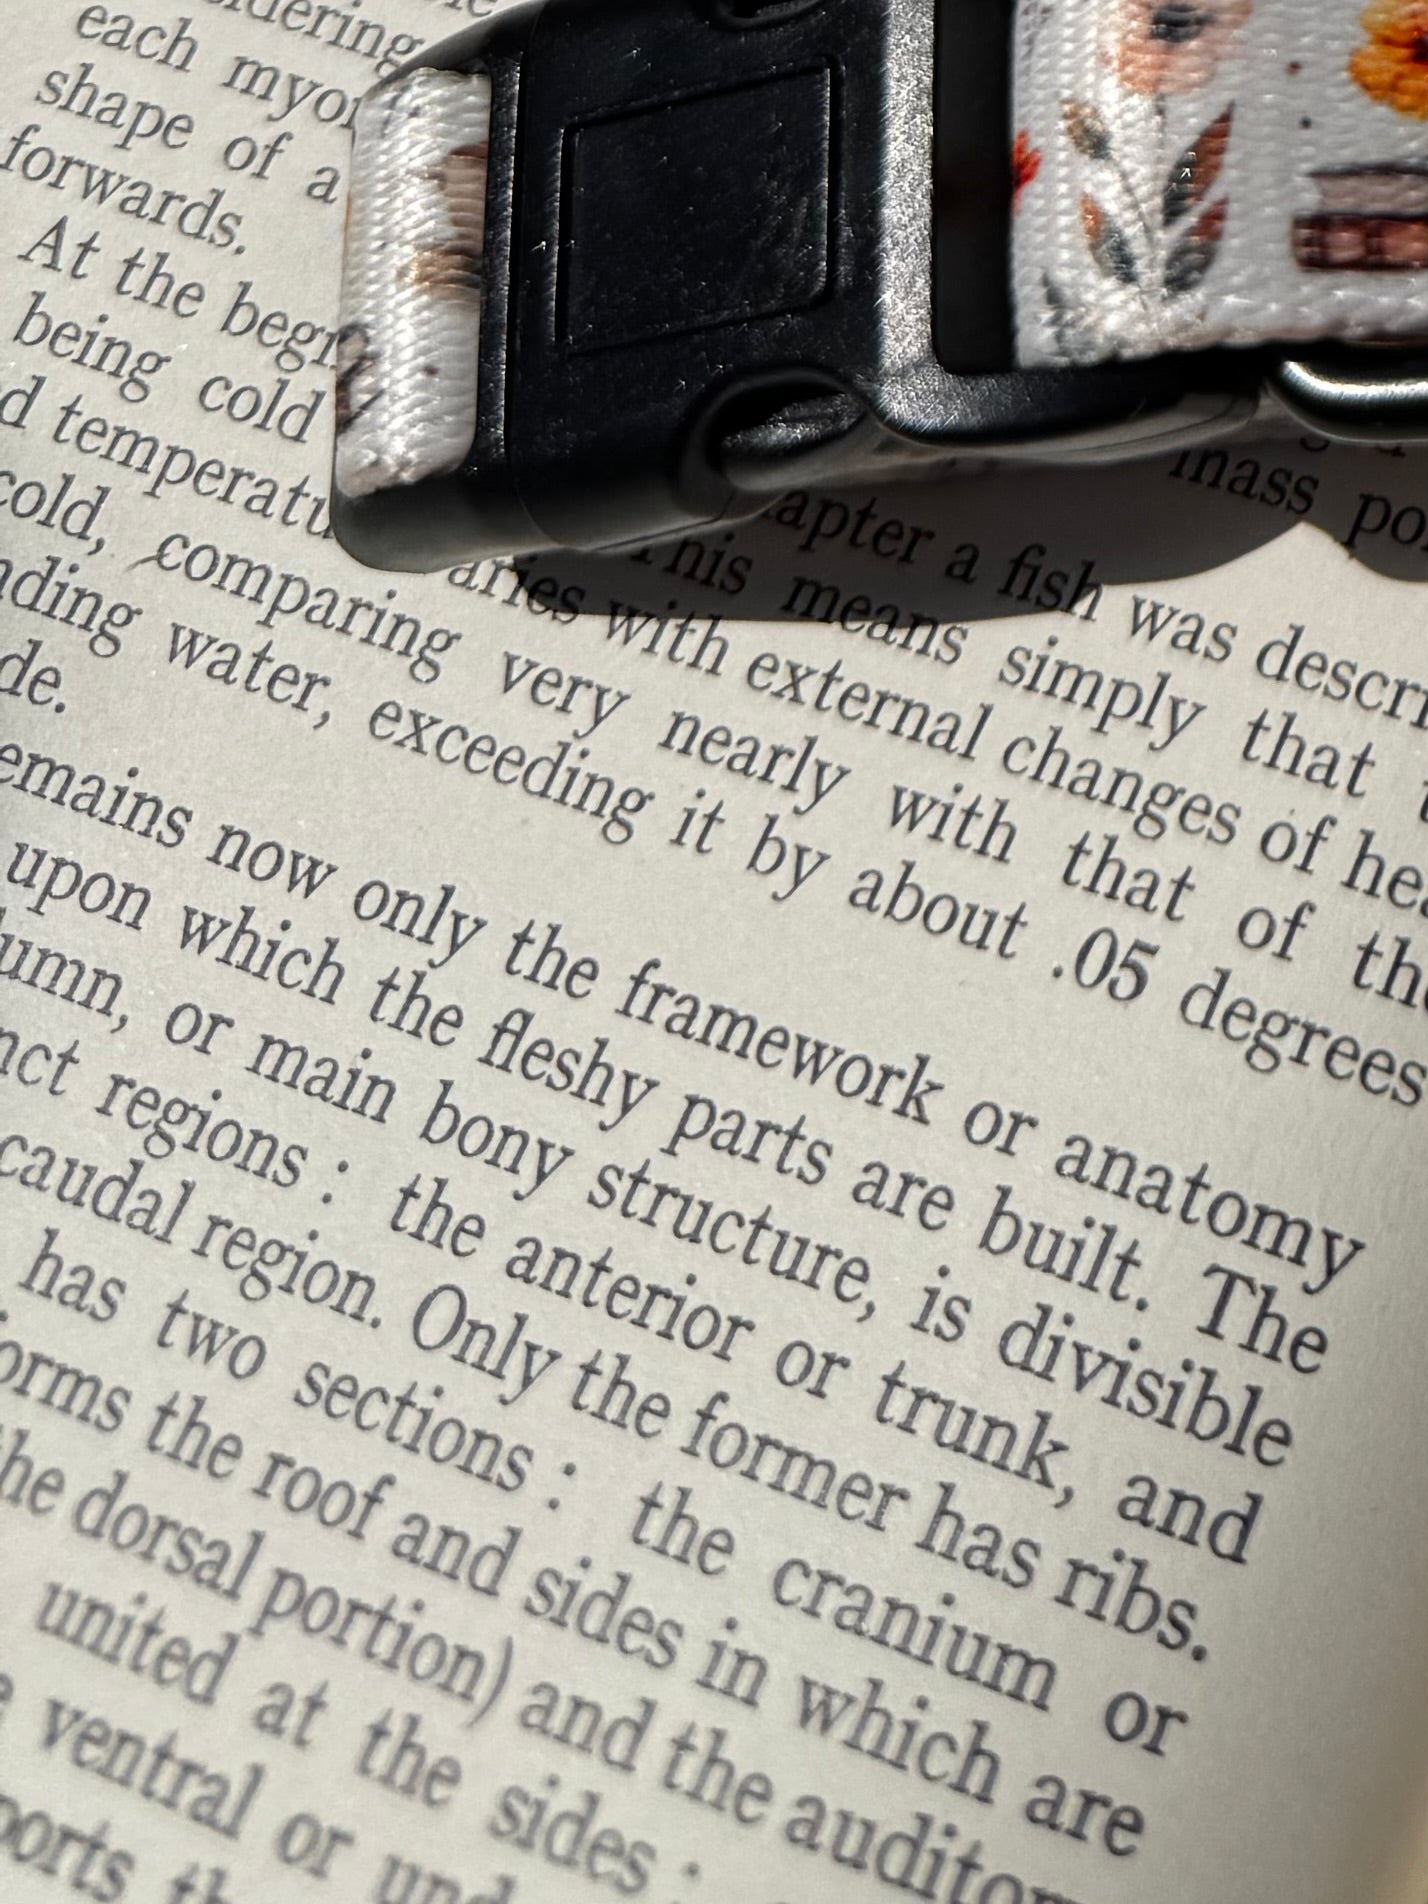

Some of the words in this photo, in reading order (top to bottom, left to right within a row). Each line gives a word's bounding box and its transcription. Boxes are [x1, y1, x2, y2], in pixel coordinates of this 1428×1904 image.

[13, 291, 172, 403] being
[198, 376, 326, 443] cold
[155, 534, 462, 684] comparing
[503, 651, 631, 740] very
[658, 711, 851, 817] nearly
[890, 785, 1016, 864] with
[1062, 831, 1195, 922] that
[1237, 900, 1316, 962] of
[746, 653, 993, 761] external
[1002, 725, 1241, 845] changes
[1259, 815, 1337, 875] of
[1130, 595, 1237, 663] was
[169, 622, 331, 730] water,
[369, 701, 655, 845] exceeding
[669, 789, 725, 855] it
[746, 813, 831, 902] by
[848, 860, 1028, 960] about
[1052, 927, 1160, 1002] .05
[1180, 967, 1427, 1108] degrees
[205, 824, 338, 899] now
[354, 880, 488, 969] only
[505, 919, 599, 1000] the
[615, 958, 944, 1126] framework
[964, 1102, 1039, 1157] or
[1054, 1135, 1366, 1296] anatomy
[571, 1349, 670, 1439] the
[680, 1391, 911, 1532] former
[914, 1482, 1041, 1589] has
[1053, 1548, 1207, 1662] ribs.
